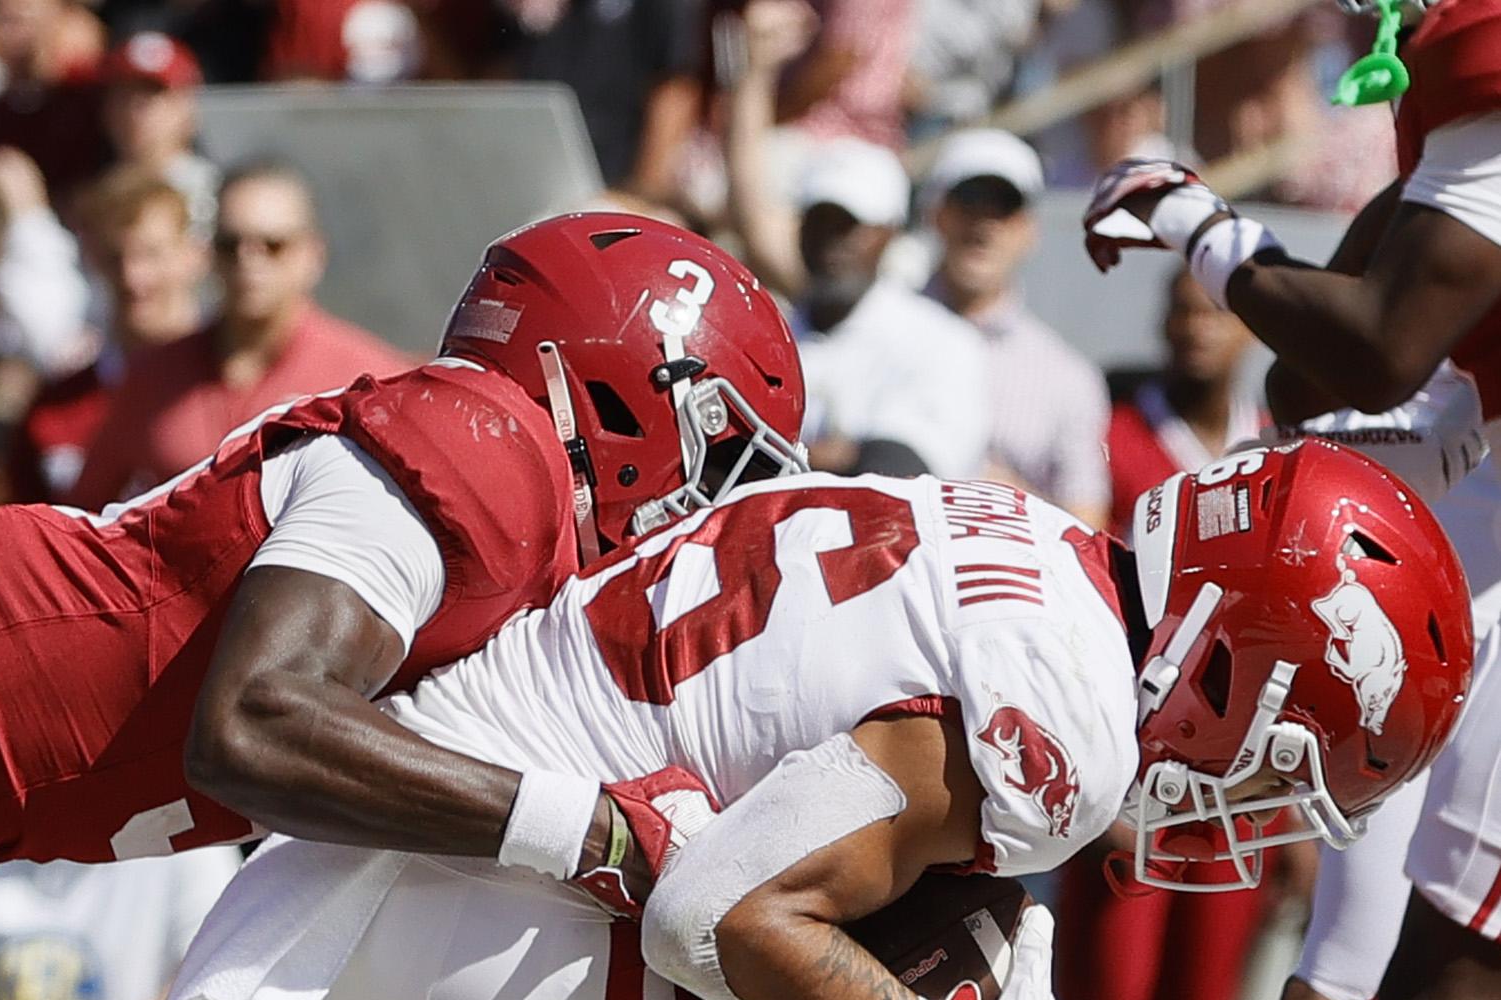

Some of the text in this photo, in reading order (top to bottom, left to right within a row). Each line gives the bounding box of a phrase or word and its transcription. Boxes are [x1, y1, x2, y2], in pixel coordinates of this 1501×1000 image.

[648, 259, 716, 336] 3
[1198, 451, 1265, 486] 6
[583, 486, 920, 706] 6
[954, 563, 1045, 608] III
[899, 948, 948, 985] VAPO
